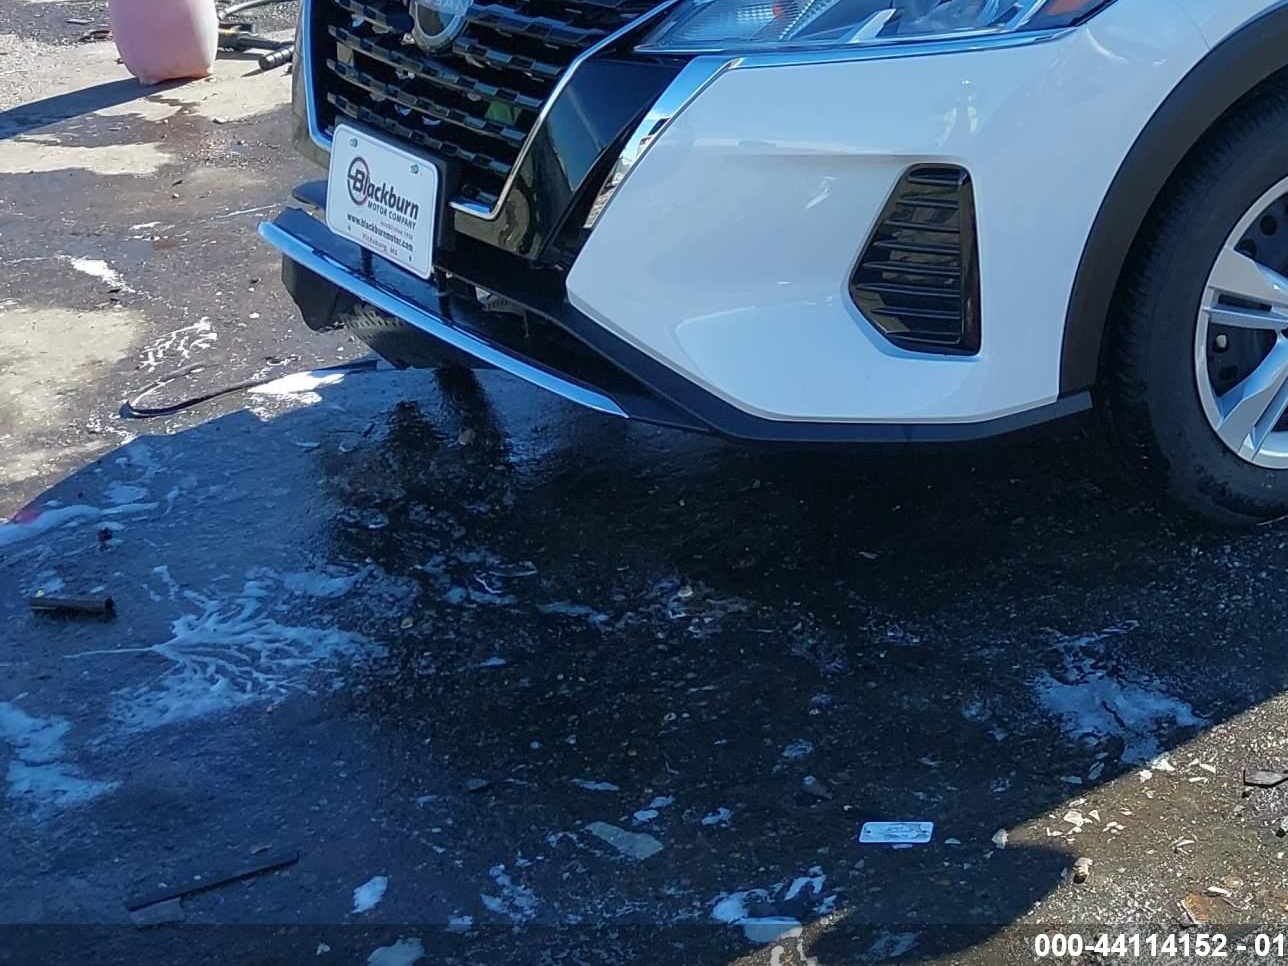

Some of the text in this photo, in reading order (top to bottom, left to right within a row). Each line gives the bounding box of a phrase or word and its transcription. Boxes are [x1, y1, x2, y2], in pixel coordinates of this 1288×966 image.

[347, 168, 419, 220] Blackburn
[347, 214, 414, 251] www.blackburnmotor.com
[367, 200, 416, 230] MOTOR COMPANY
